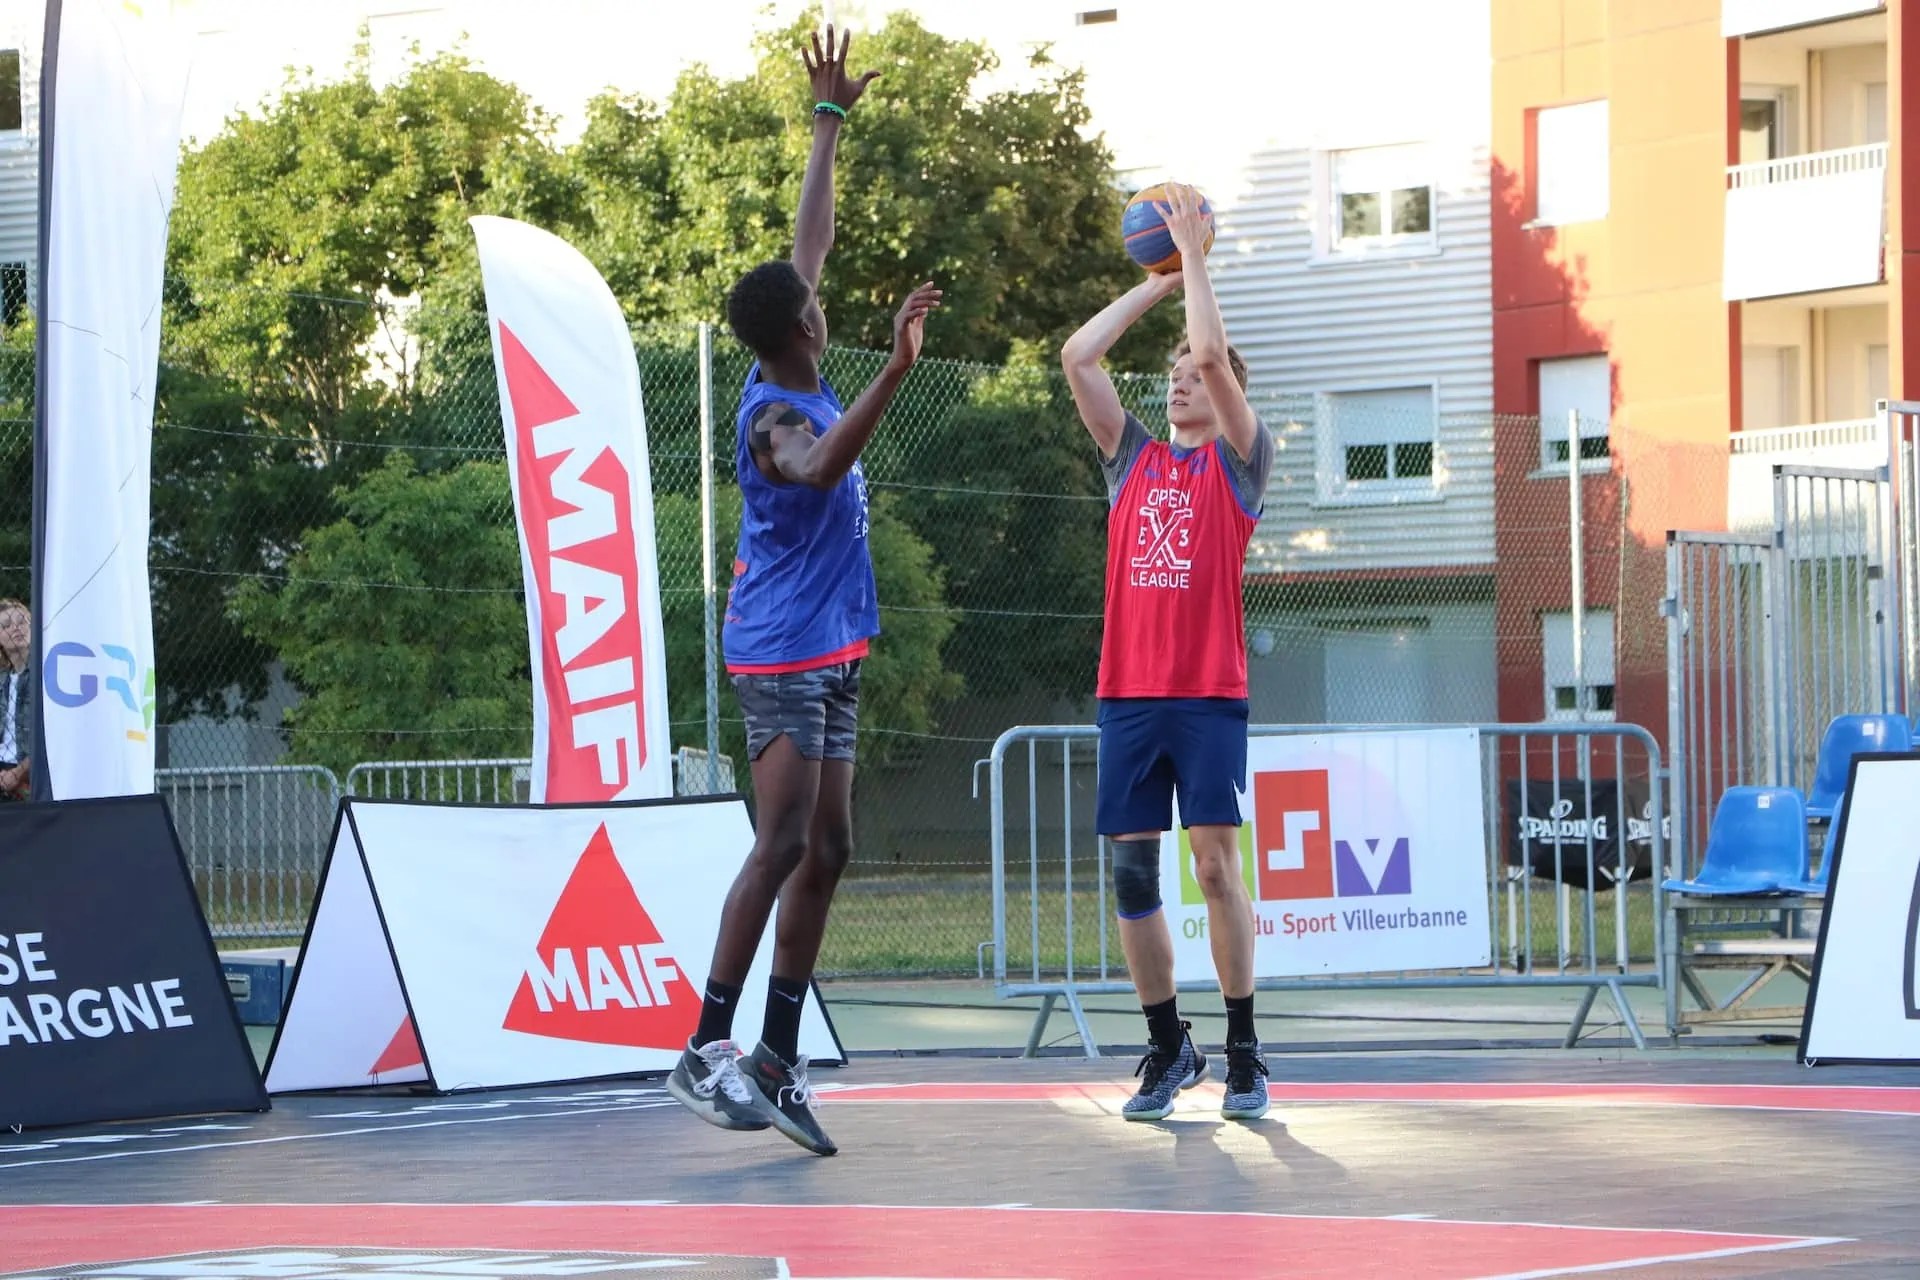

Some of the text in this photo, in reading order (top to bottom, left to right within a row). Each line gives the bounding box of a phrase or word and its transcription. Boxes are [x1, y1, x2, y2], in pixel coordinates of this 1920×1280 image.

[1147, 488, 1191, 508] OPEN
[1130, 571, 1191, 589] LEAGUE
[531, 412, 642, 787] MAIF
[1283, 911, 1337, 939] Sport
[1342, 907, 1468, 932] Villeurbanne
[526, 942, 680, 1013] MAIF
